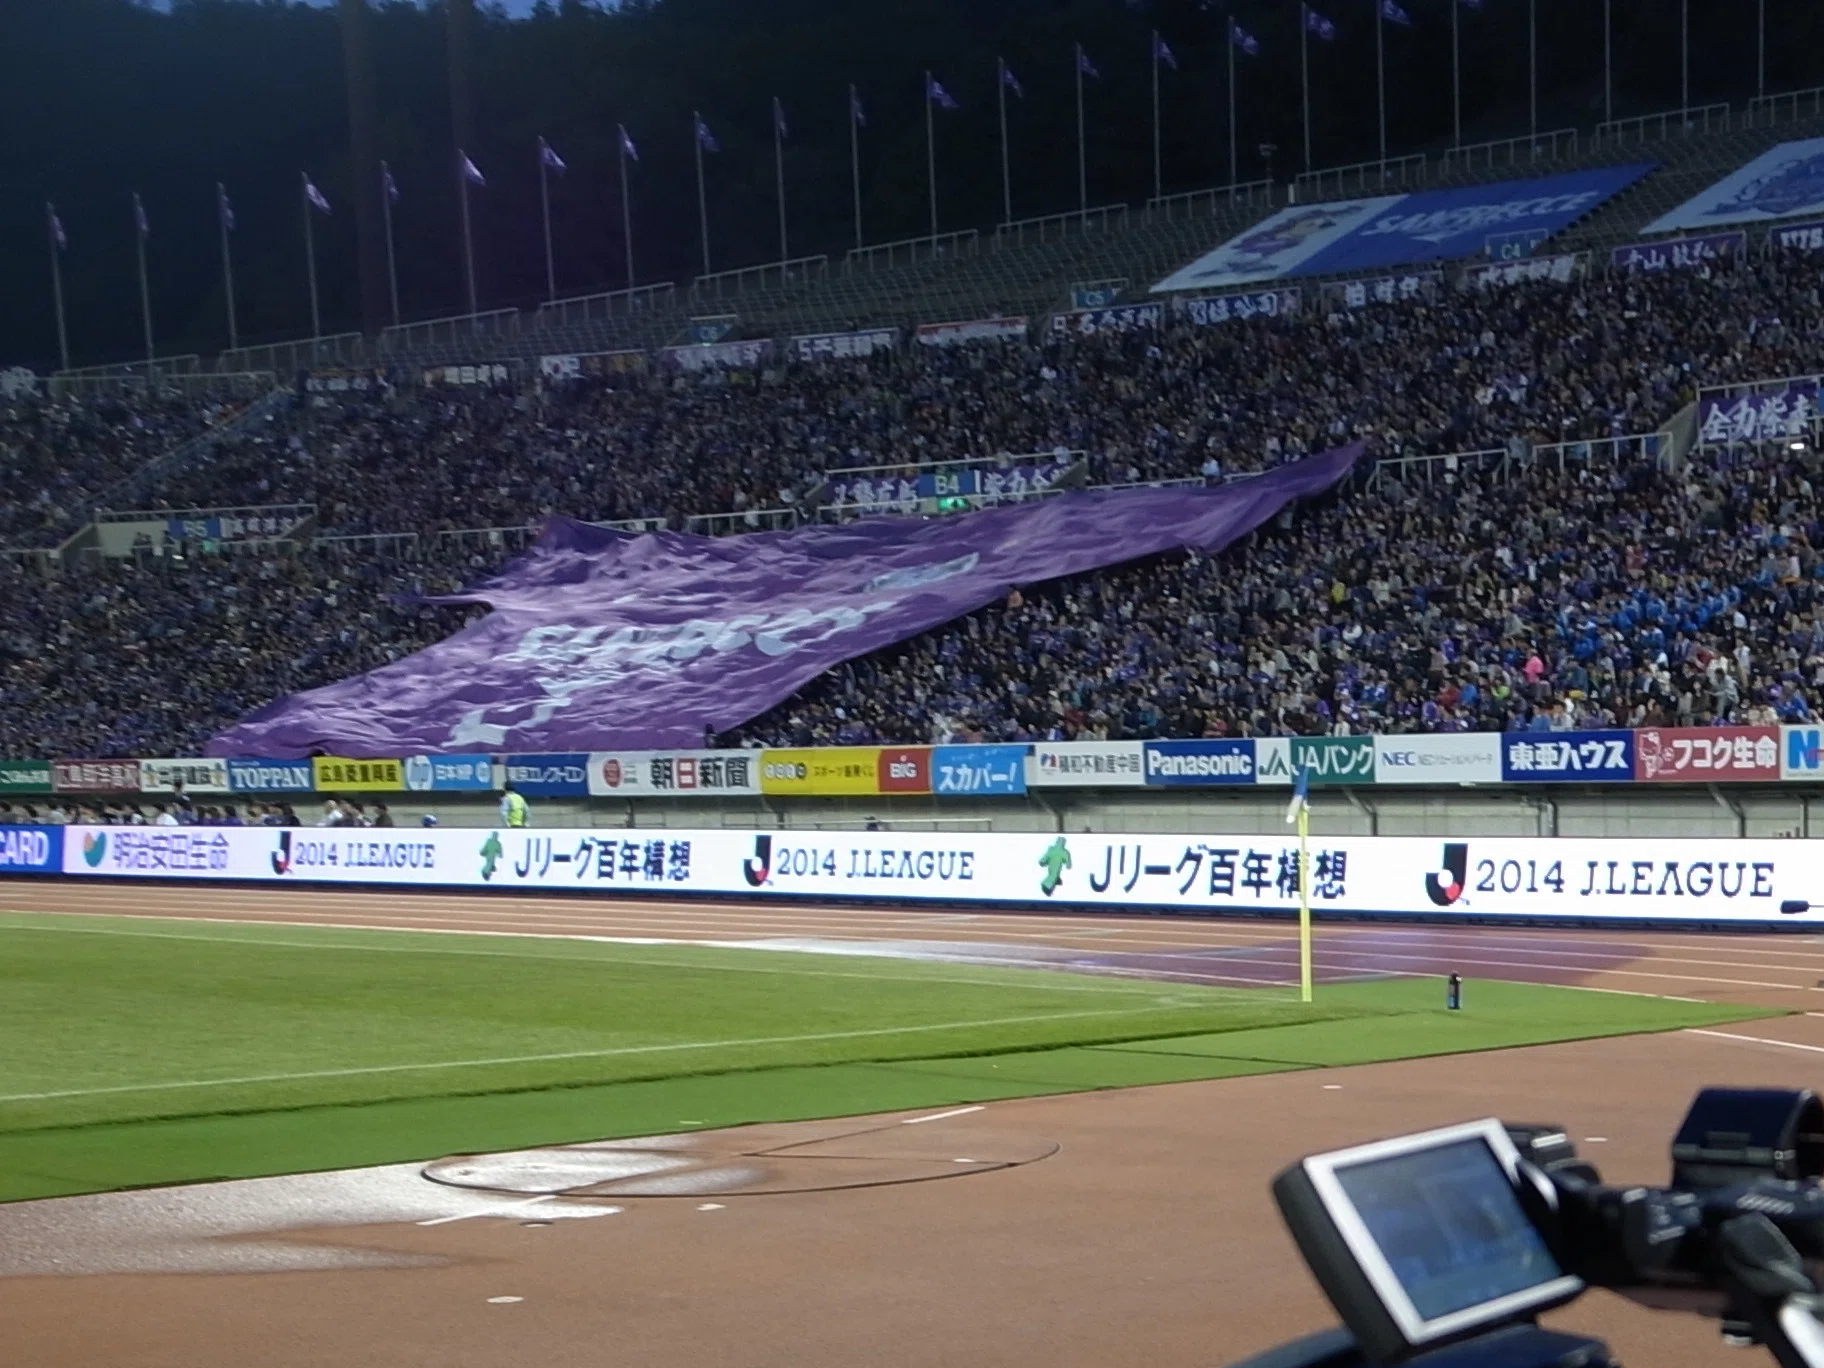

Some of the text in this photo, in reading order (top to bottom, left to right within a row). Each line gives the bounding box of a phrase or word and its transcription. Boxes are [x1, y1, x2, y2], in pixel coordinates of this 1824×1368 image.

[933, 474, 961, 495] B4
[1147, 746, 1253, 776] Panasonic
[1382, 751, 1416, 767] NEC
[1508, 740, 1629, 771] 東亜ハウス
[1671, 735, 1778, 770] フコク生命
[233, 766, 310, 788] TOPPAN
[650, 756, 751, 789] 朝日新聞
[938, 762, 1017, 791] スカパー!
[112, 831, 229, 870] 明治安田生命
[295, 842, 338, 867] 2014
[515, 836, 692, 882] Jリーグ百年構想
[777, 848, 975, 880] 2014 J.LEAGUE
[1089, 843, 1348, 899] Jリーグ百年構想
[1477, 858, 1775, 898] 2014 J.LEAGUE
